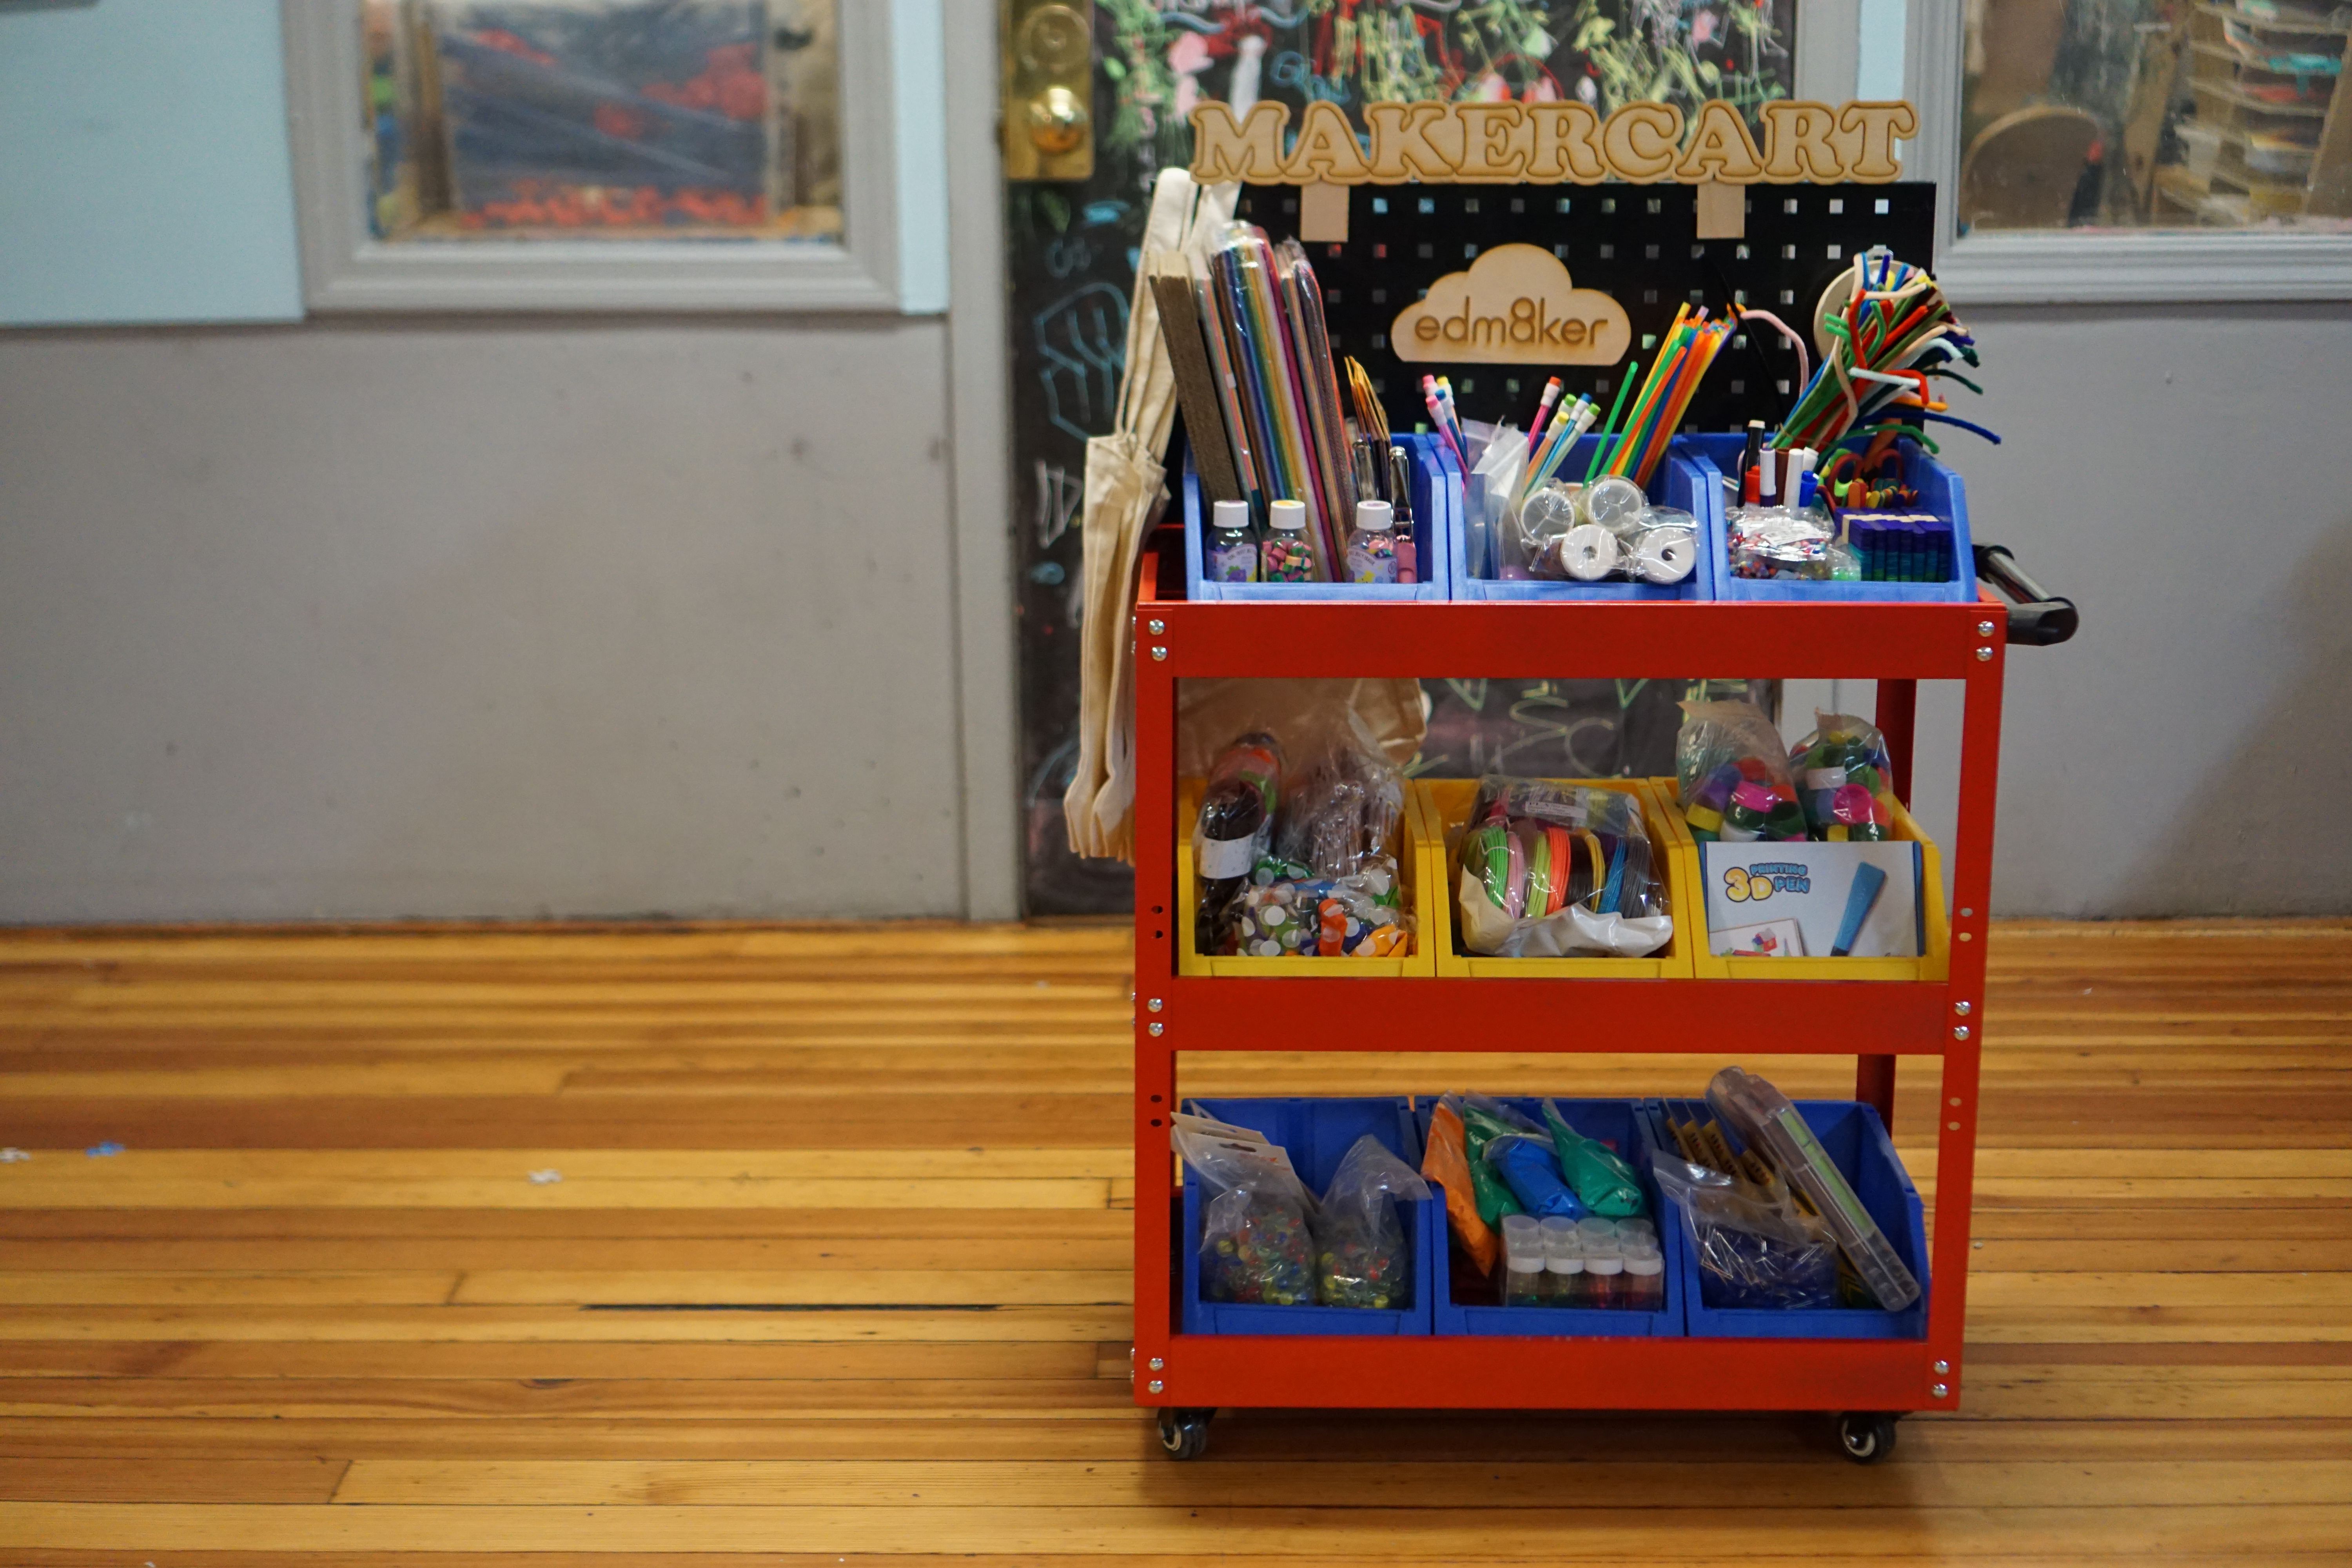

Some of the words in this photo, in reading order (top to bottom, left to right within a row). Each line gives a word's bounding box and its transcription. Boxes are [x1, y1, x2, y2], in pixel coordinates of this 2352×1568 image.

[1192, 101, 1918, 181] MAKERCART
[1414, 295, 1608, 345] edm8ker
[1724, 867, 1774, 902] 3D
[1773, 876, 1810, 894] PEN
[1749, 862, 1808, 877] PRINTING
